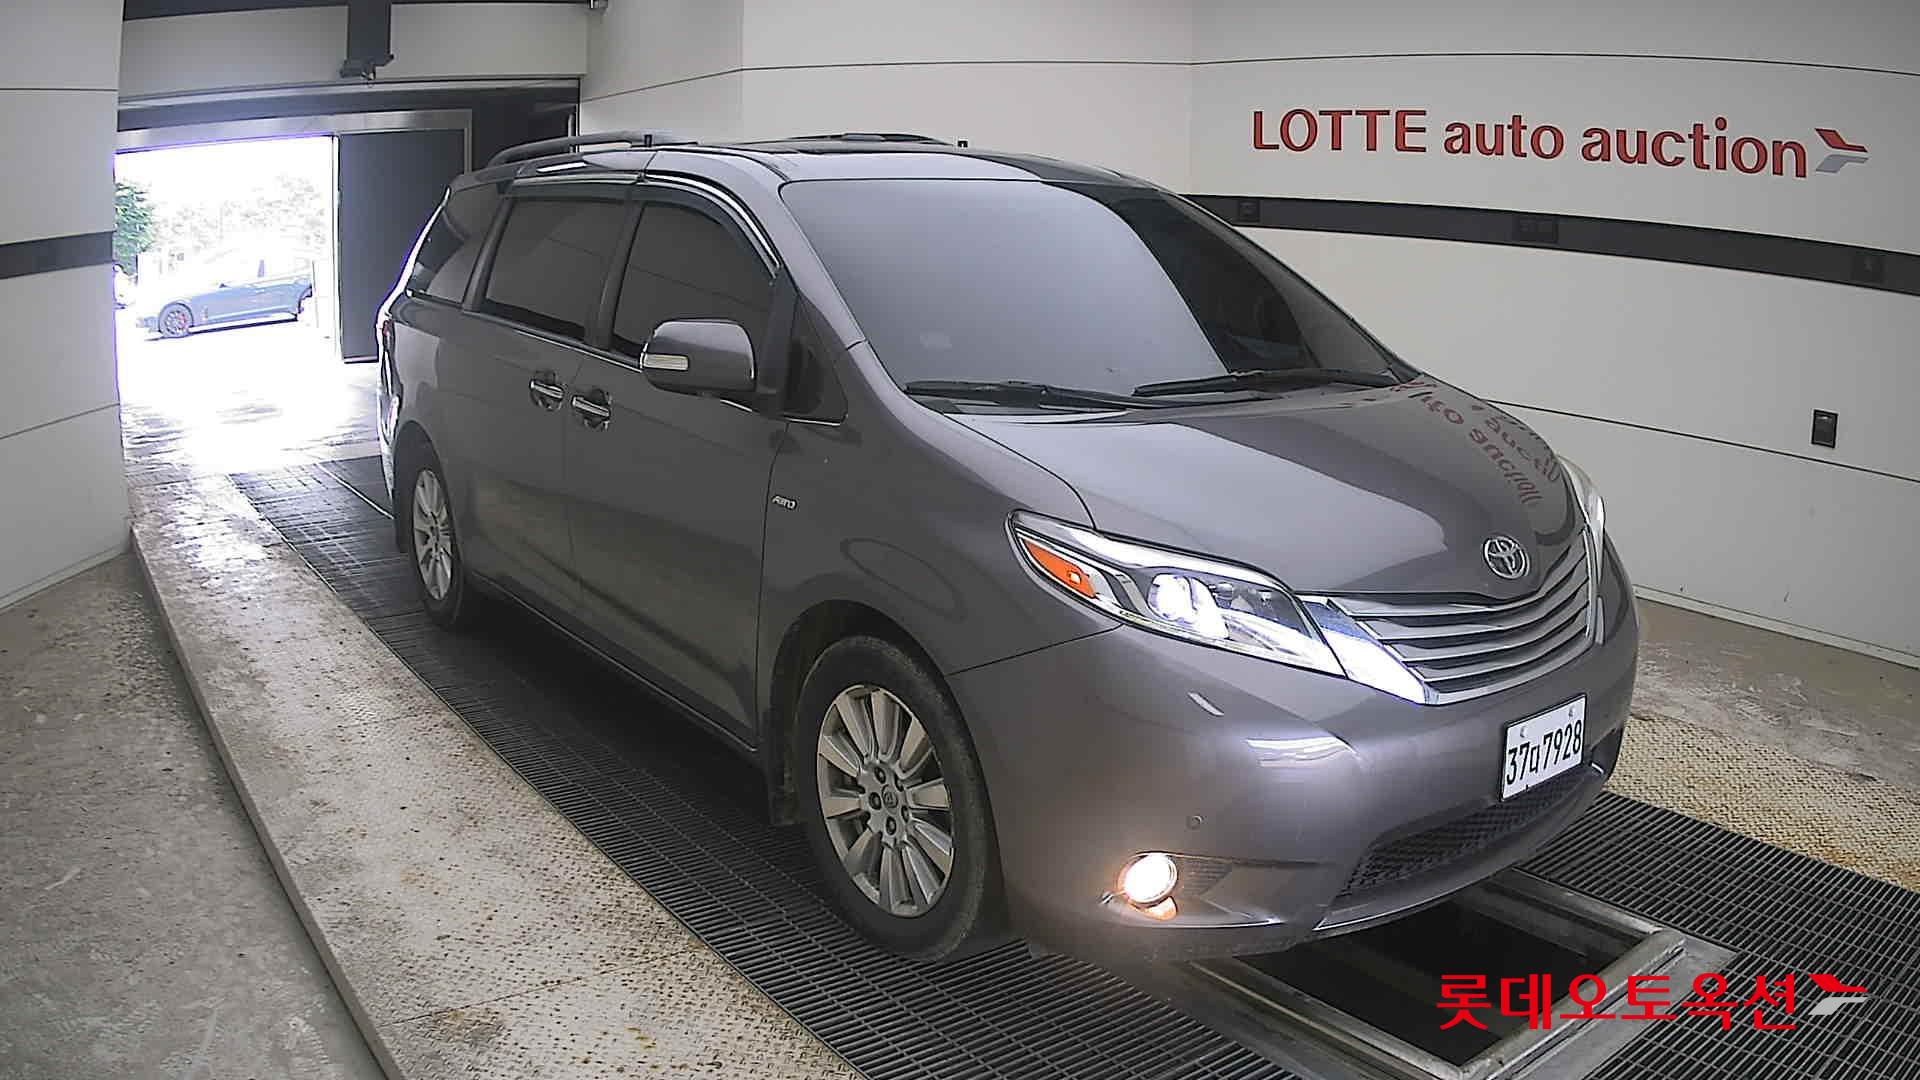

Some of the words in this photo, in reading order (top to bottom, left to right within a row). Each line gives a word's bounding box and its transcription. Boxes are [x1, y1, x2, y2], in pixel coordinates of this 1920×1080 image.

[1252, 109, 1427, 152] LOTTE
[1443, 115, 1565, 160] auto
[1581, 116, 1807, 178] auction
